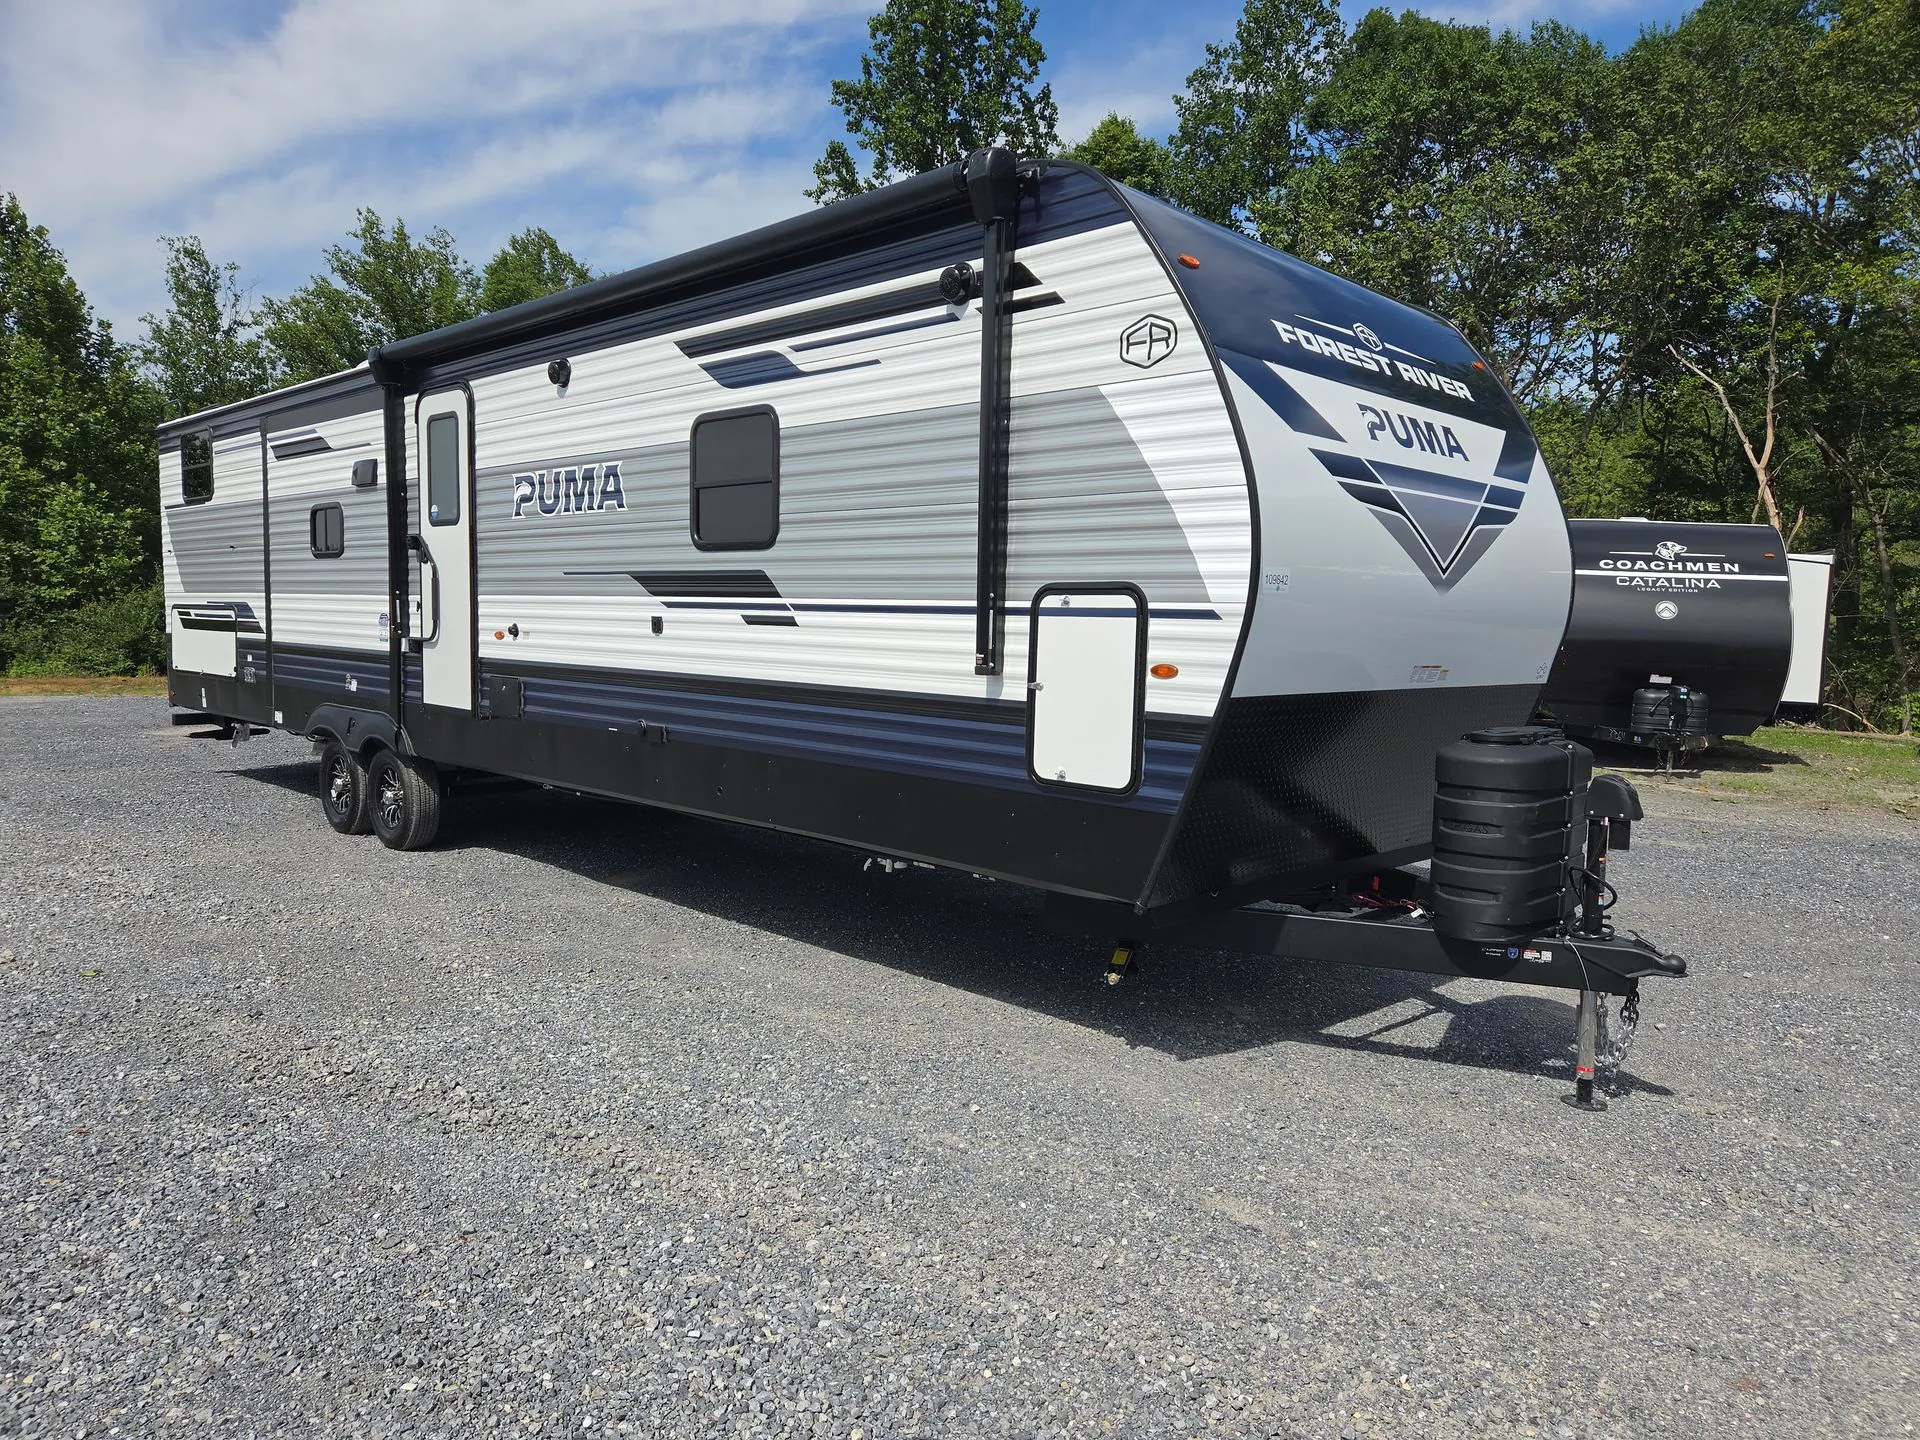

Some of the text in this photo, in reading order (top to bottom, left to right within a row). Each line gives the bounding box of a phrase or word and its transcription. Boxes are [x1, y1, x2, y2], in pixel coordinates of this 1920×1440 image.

[1270, 318, 1475, 402] FOREST RIVER
[1356, 402, 1470, 462] PUMA
[512, 460, 628, 519] PUMA
[1265, 574, 1289, 586] 109842
[1599, 559, 1740, 573] COACHMEN
[1616, 576, 1721, 589] CATALINA
